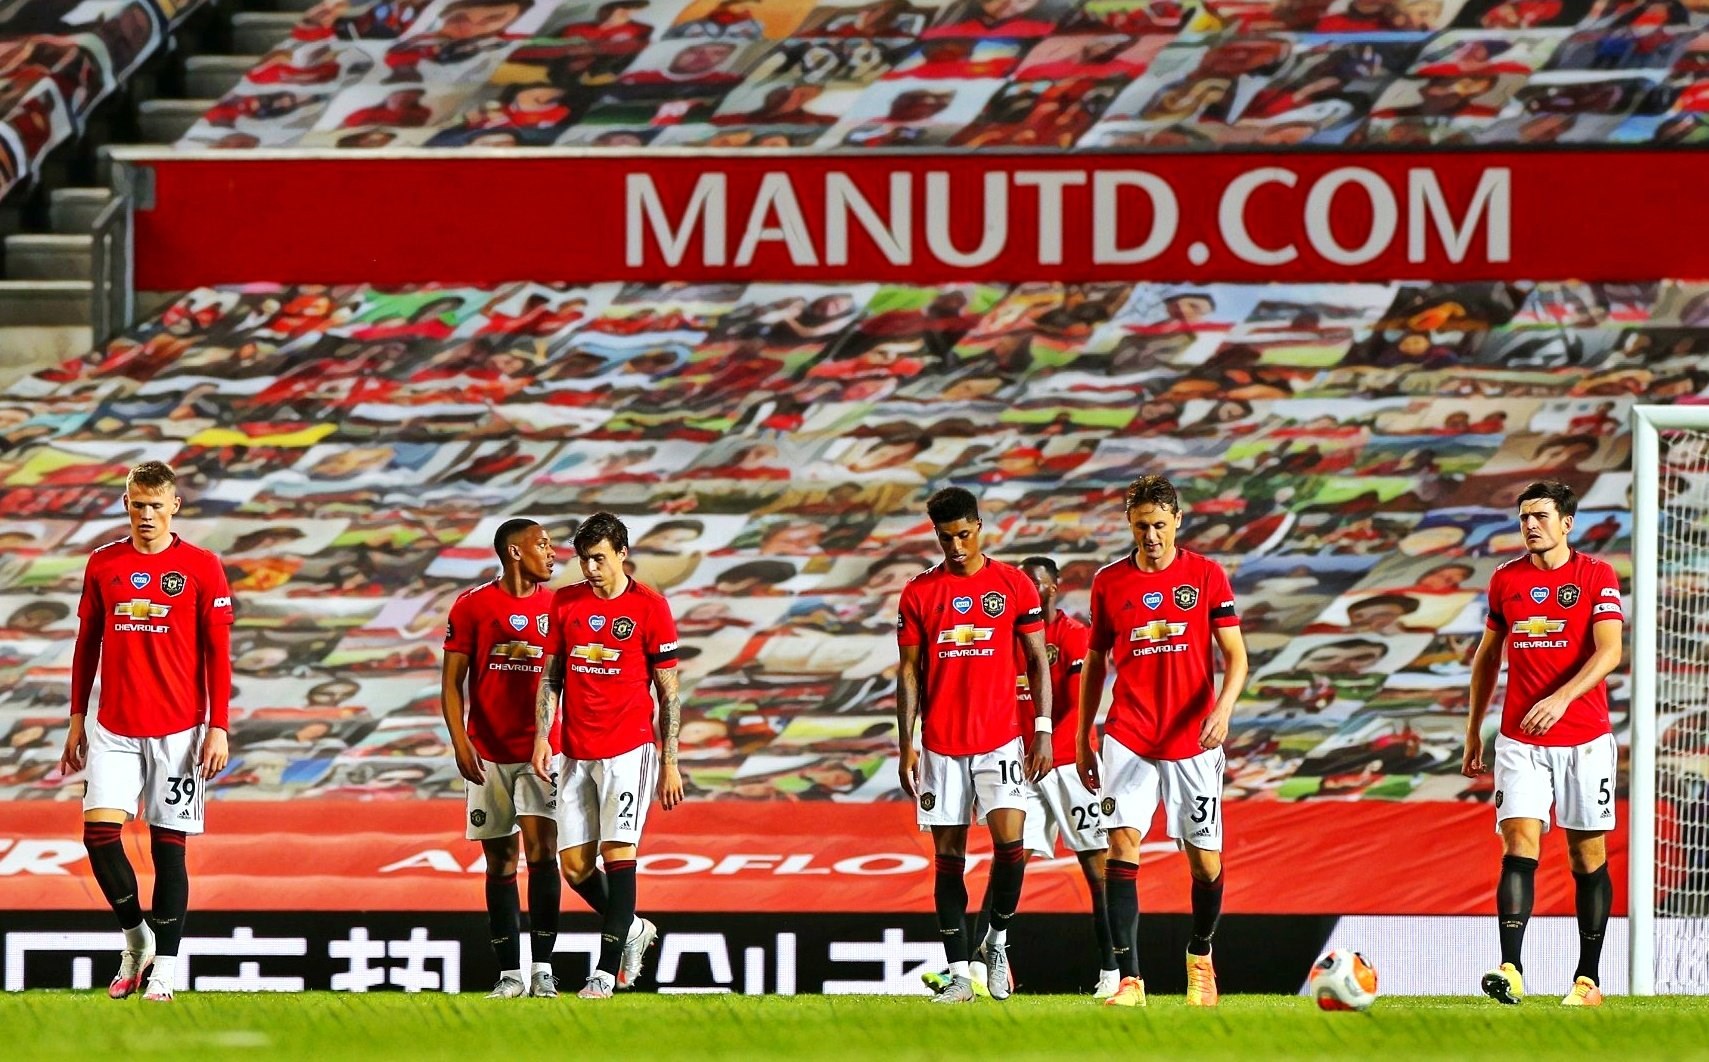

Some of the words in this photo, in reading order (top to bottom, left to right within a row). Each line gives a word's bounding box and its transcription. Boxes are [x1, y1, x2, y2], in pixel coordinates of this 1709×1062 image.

[624, 166, 1513, 268] MANUTD.COM
[114, 623, 170, 633] CHEVROLET
[938, 649, 995, 659] CHEVROLET
[1133, 644, 1189, 657] CHEVROLET
[1513, 640, 1569, 649] CHEVROLET
[489, 663, 543, 673] CHEVROLET
[571, 664, 621, 675] CHEVROLET
[998, 760, 1023, 785] 10
[165, 776, 196, 806] 39
[1597, 777, 1610, 806] 5
[618, 791, 634, 818] 2
[1071, 802, 1100, 831] 29
[1190, 795, 1217, 825] 31
